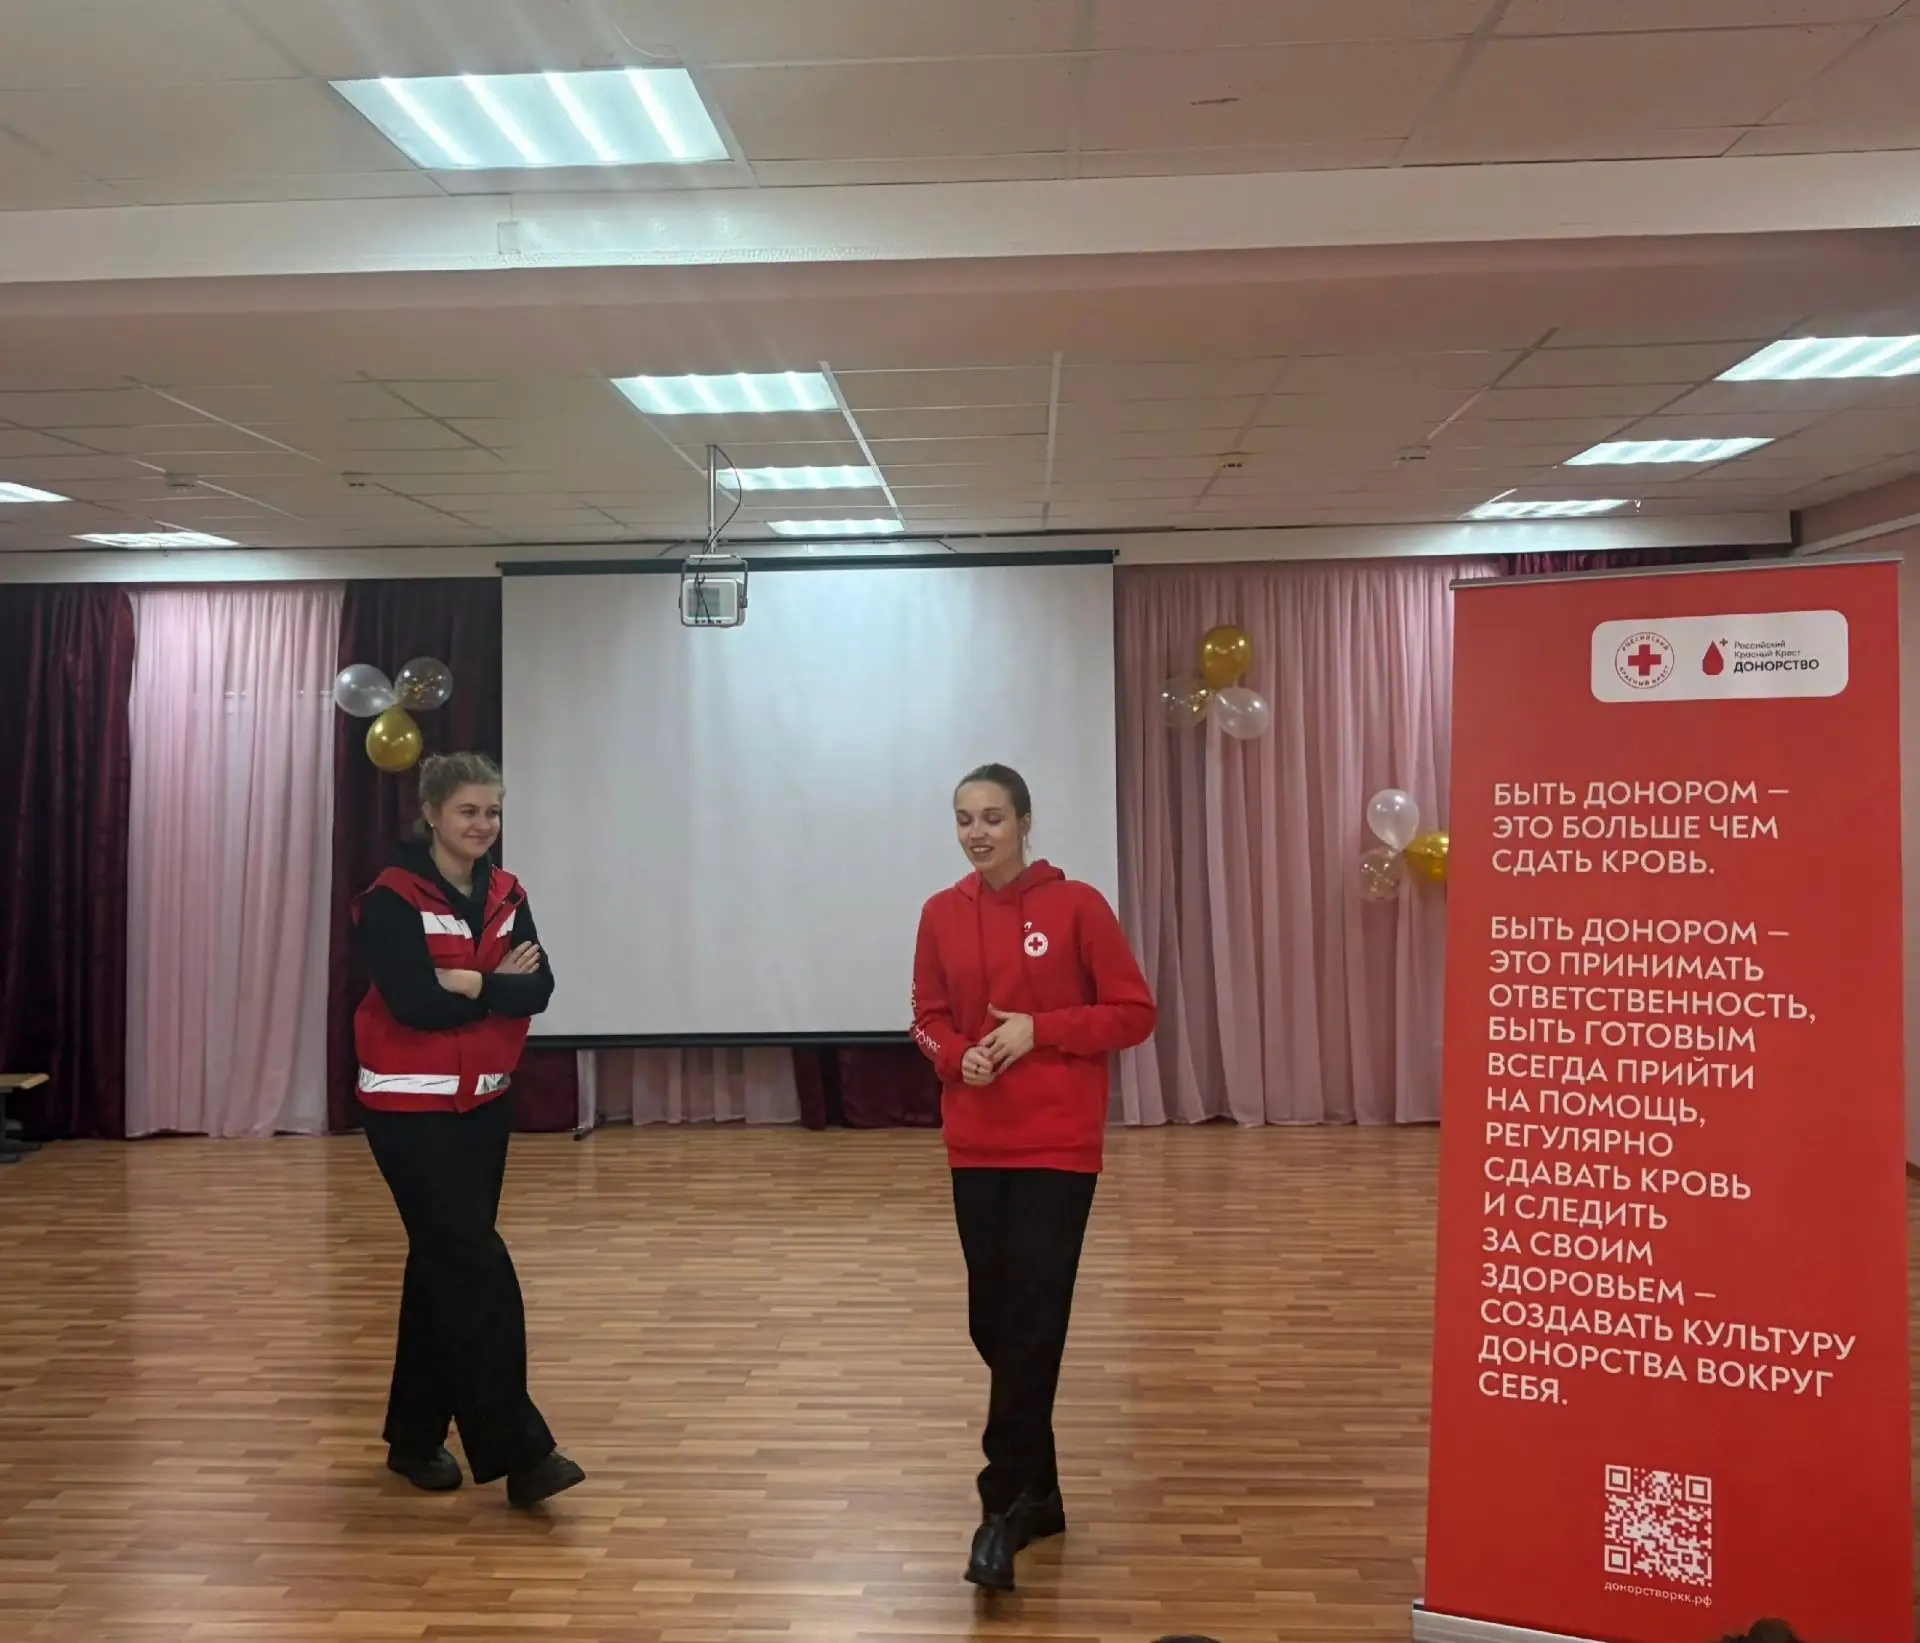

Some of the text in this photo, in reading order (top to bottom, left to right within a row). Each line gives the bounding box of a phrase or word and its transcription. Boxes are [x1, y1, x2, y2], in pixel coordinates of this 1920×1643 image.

[1733, 659, 1820, 674] ДОНОРСТВО
[1494, 782, 1577, 806] БЫТЬ
[1583, 780, 1758, 810] ДОНОРОМ
[1492, 815, 1779, 840] ЭТО БОЛЬШЕ ЧЕМ
[1491, 848, 1715, 877] СДАТЬ КРОВЬ.
[1491, 915, 1575, 941] БЫТЬ
[1581, 918, 1758, 947] ДОНОРОМ
[1489, 949, 1765, 982] ЭТО ПРИНИМАТЬ
[1488, 983, 1816, 1024] ОТВЕТСТВЕННОСТЬ,
[1488, 1016, 1756, 1053] БЫТЬ ГОТОВЫМ
[1488, 1052, 1754, 1090] ВСЕГДА ПРИЙТИ
[1487, 1086, 1706, 1128] НА ПОМОЩЬ,
[1485, 1121, 1674, 1158] РЕГУЛЯРНО
[1484, 1156, 1752, 1200] СДАВАТЬ КРОВЬ
[1484, 1191, 1668, 1230] И СЛЕДИТЬ
[1482, 1226, 1653, 1266] ЗА СВОИМ
[1481, 1262, 1685, 1306] ЗДОРОВЬЕМ
[1480, 1298, 1856, 1361] СОЗДАВАТЬ КУЛЬТУРУ
[1478, 1335, 1834, 1397] ДОНОРСТВА ВОКРУГ
[1478, 1370, 1568, 1405] СЕБЯ.
